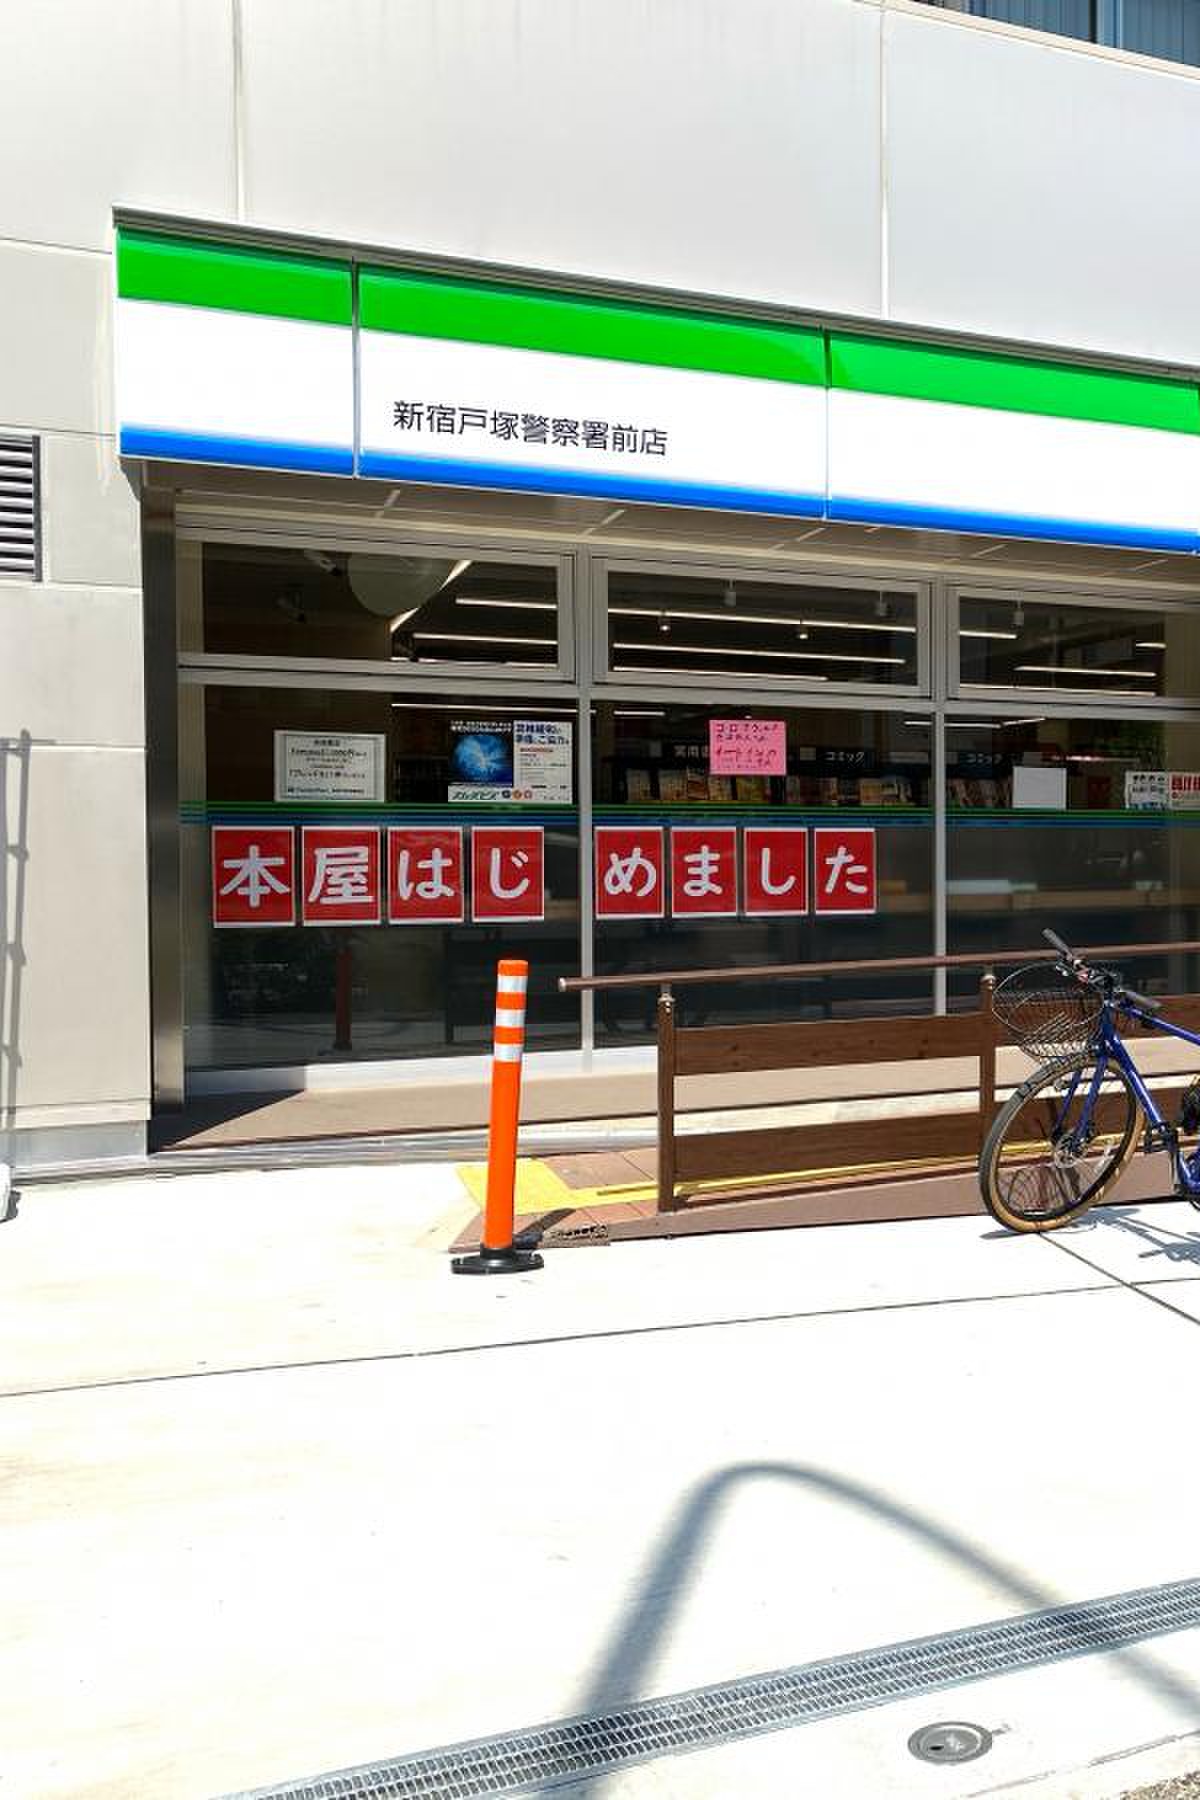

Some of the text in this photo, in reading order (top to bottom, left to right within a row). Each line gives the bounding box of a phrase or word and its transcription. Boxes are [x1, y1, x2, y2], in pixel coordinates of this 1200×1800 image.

[393, 400, 669, 456] 新宿戸塚警察署前店
[219, 845, 868, 907] 本屋はじめました
